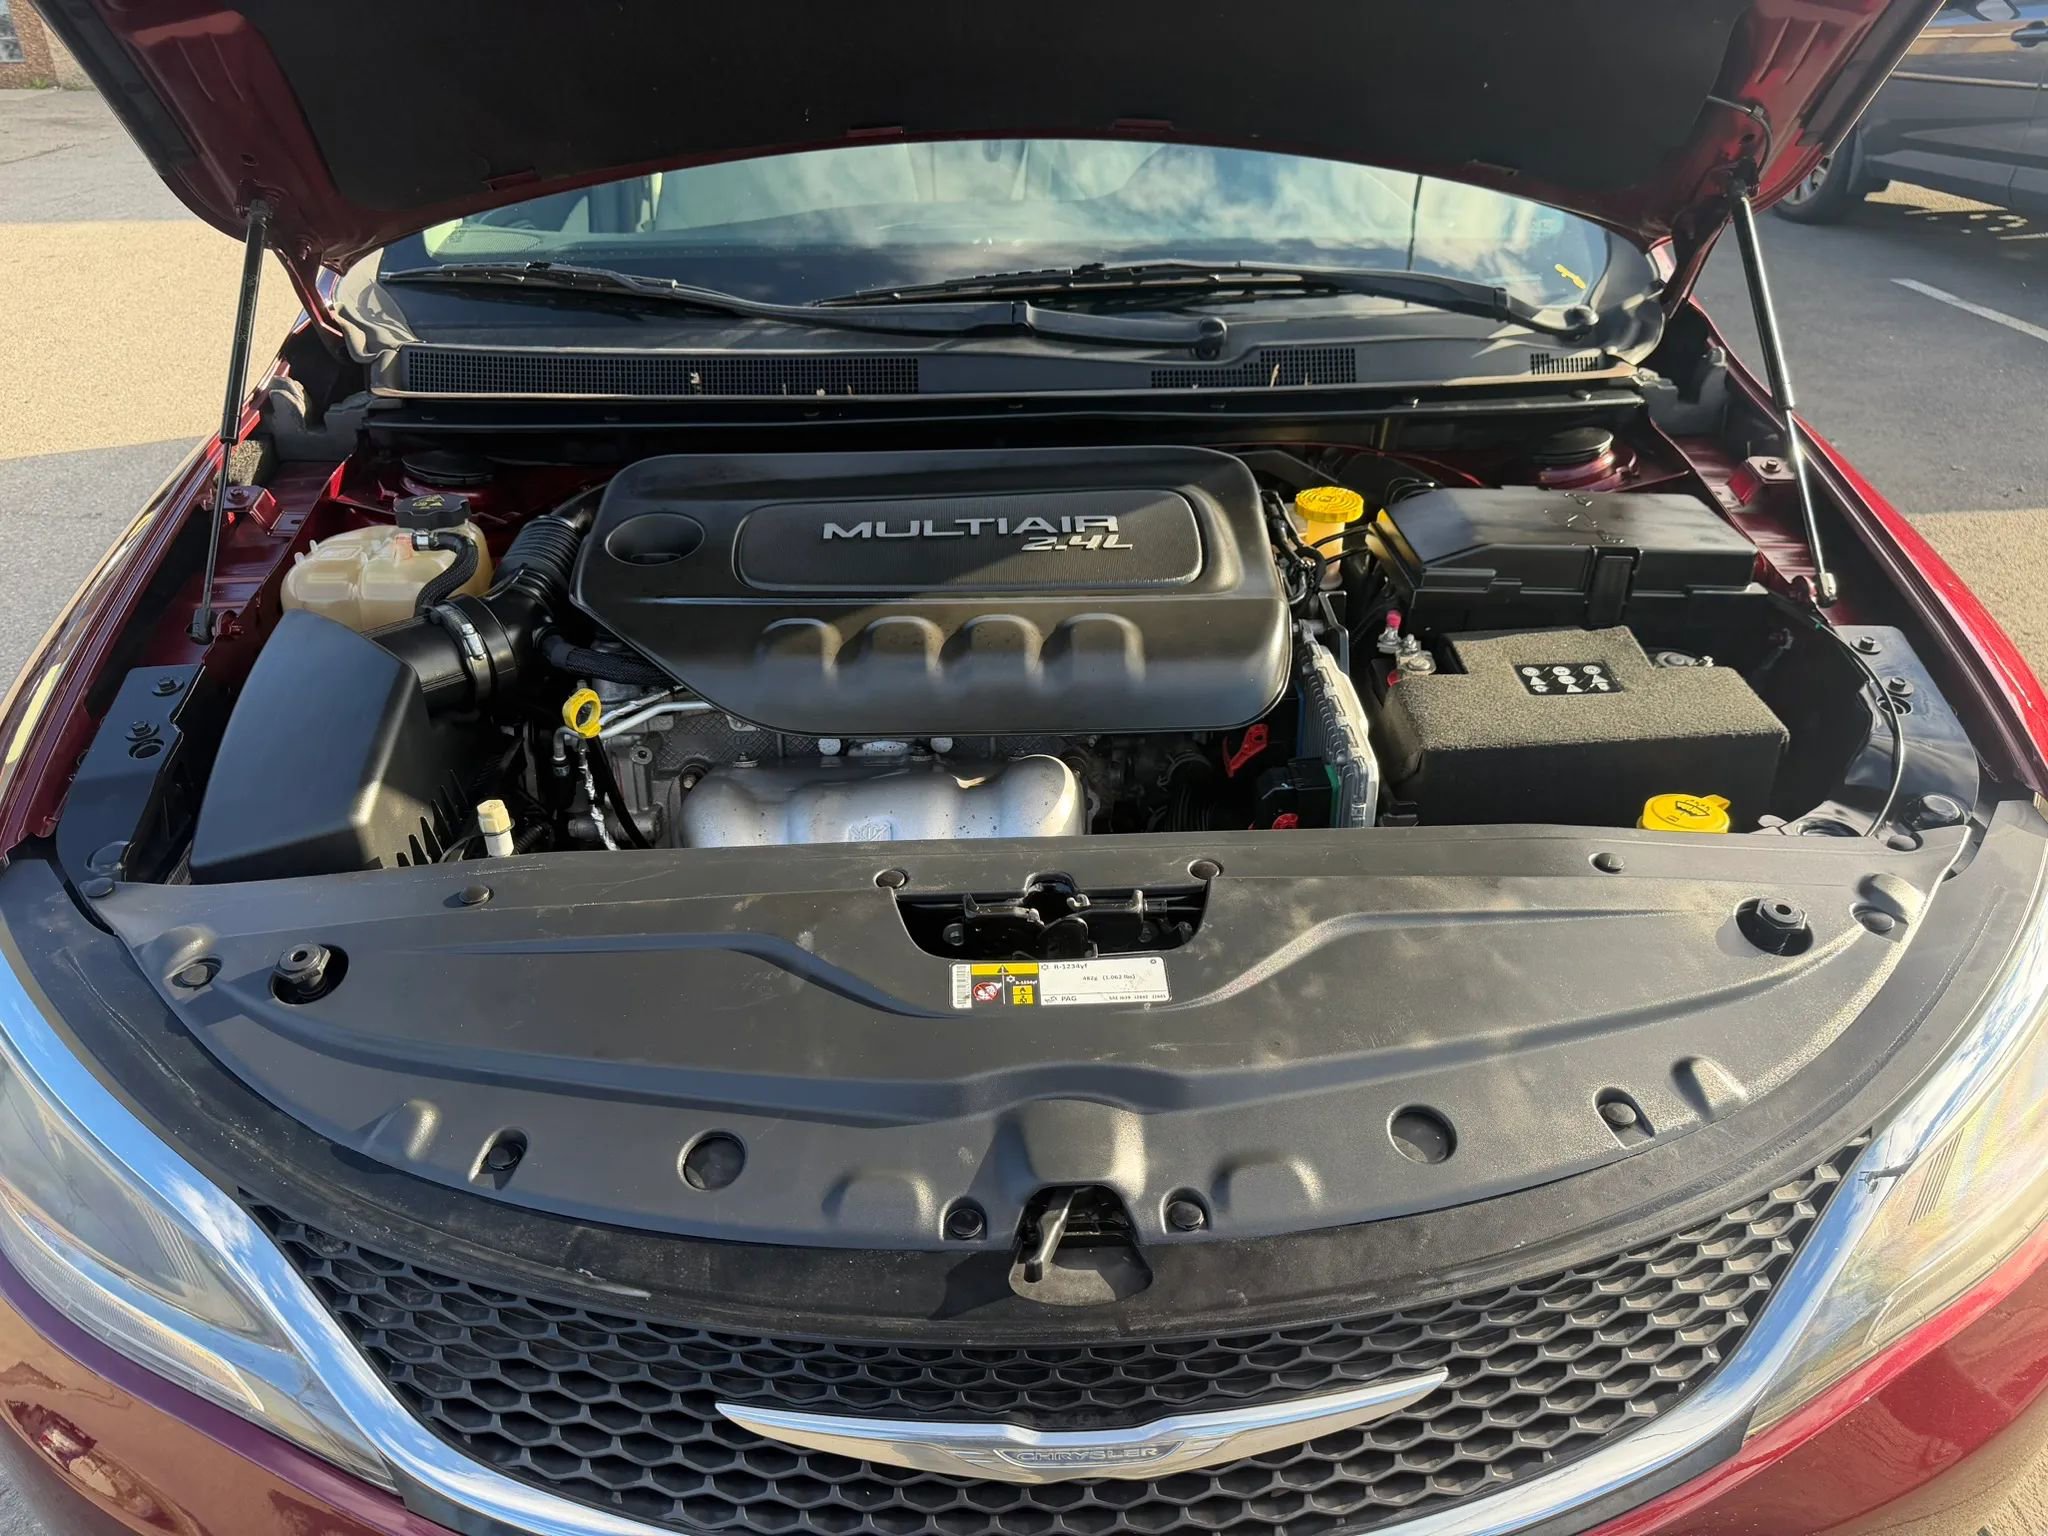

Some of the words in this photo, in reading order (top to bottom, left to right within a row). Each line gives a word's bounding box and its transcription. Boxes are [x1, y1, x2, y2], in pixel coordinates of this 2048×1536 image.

[823, 515, 1120, 540] MULTIAIR
[1020, 534, 1133, 551] 2.4L
[1053, 963, 1088, 971] R-1234yf
[1016, 1448, 1158, 1461] CHRYSLER
